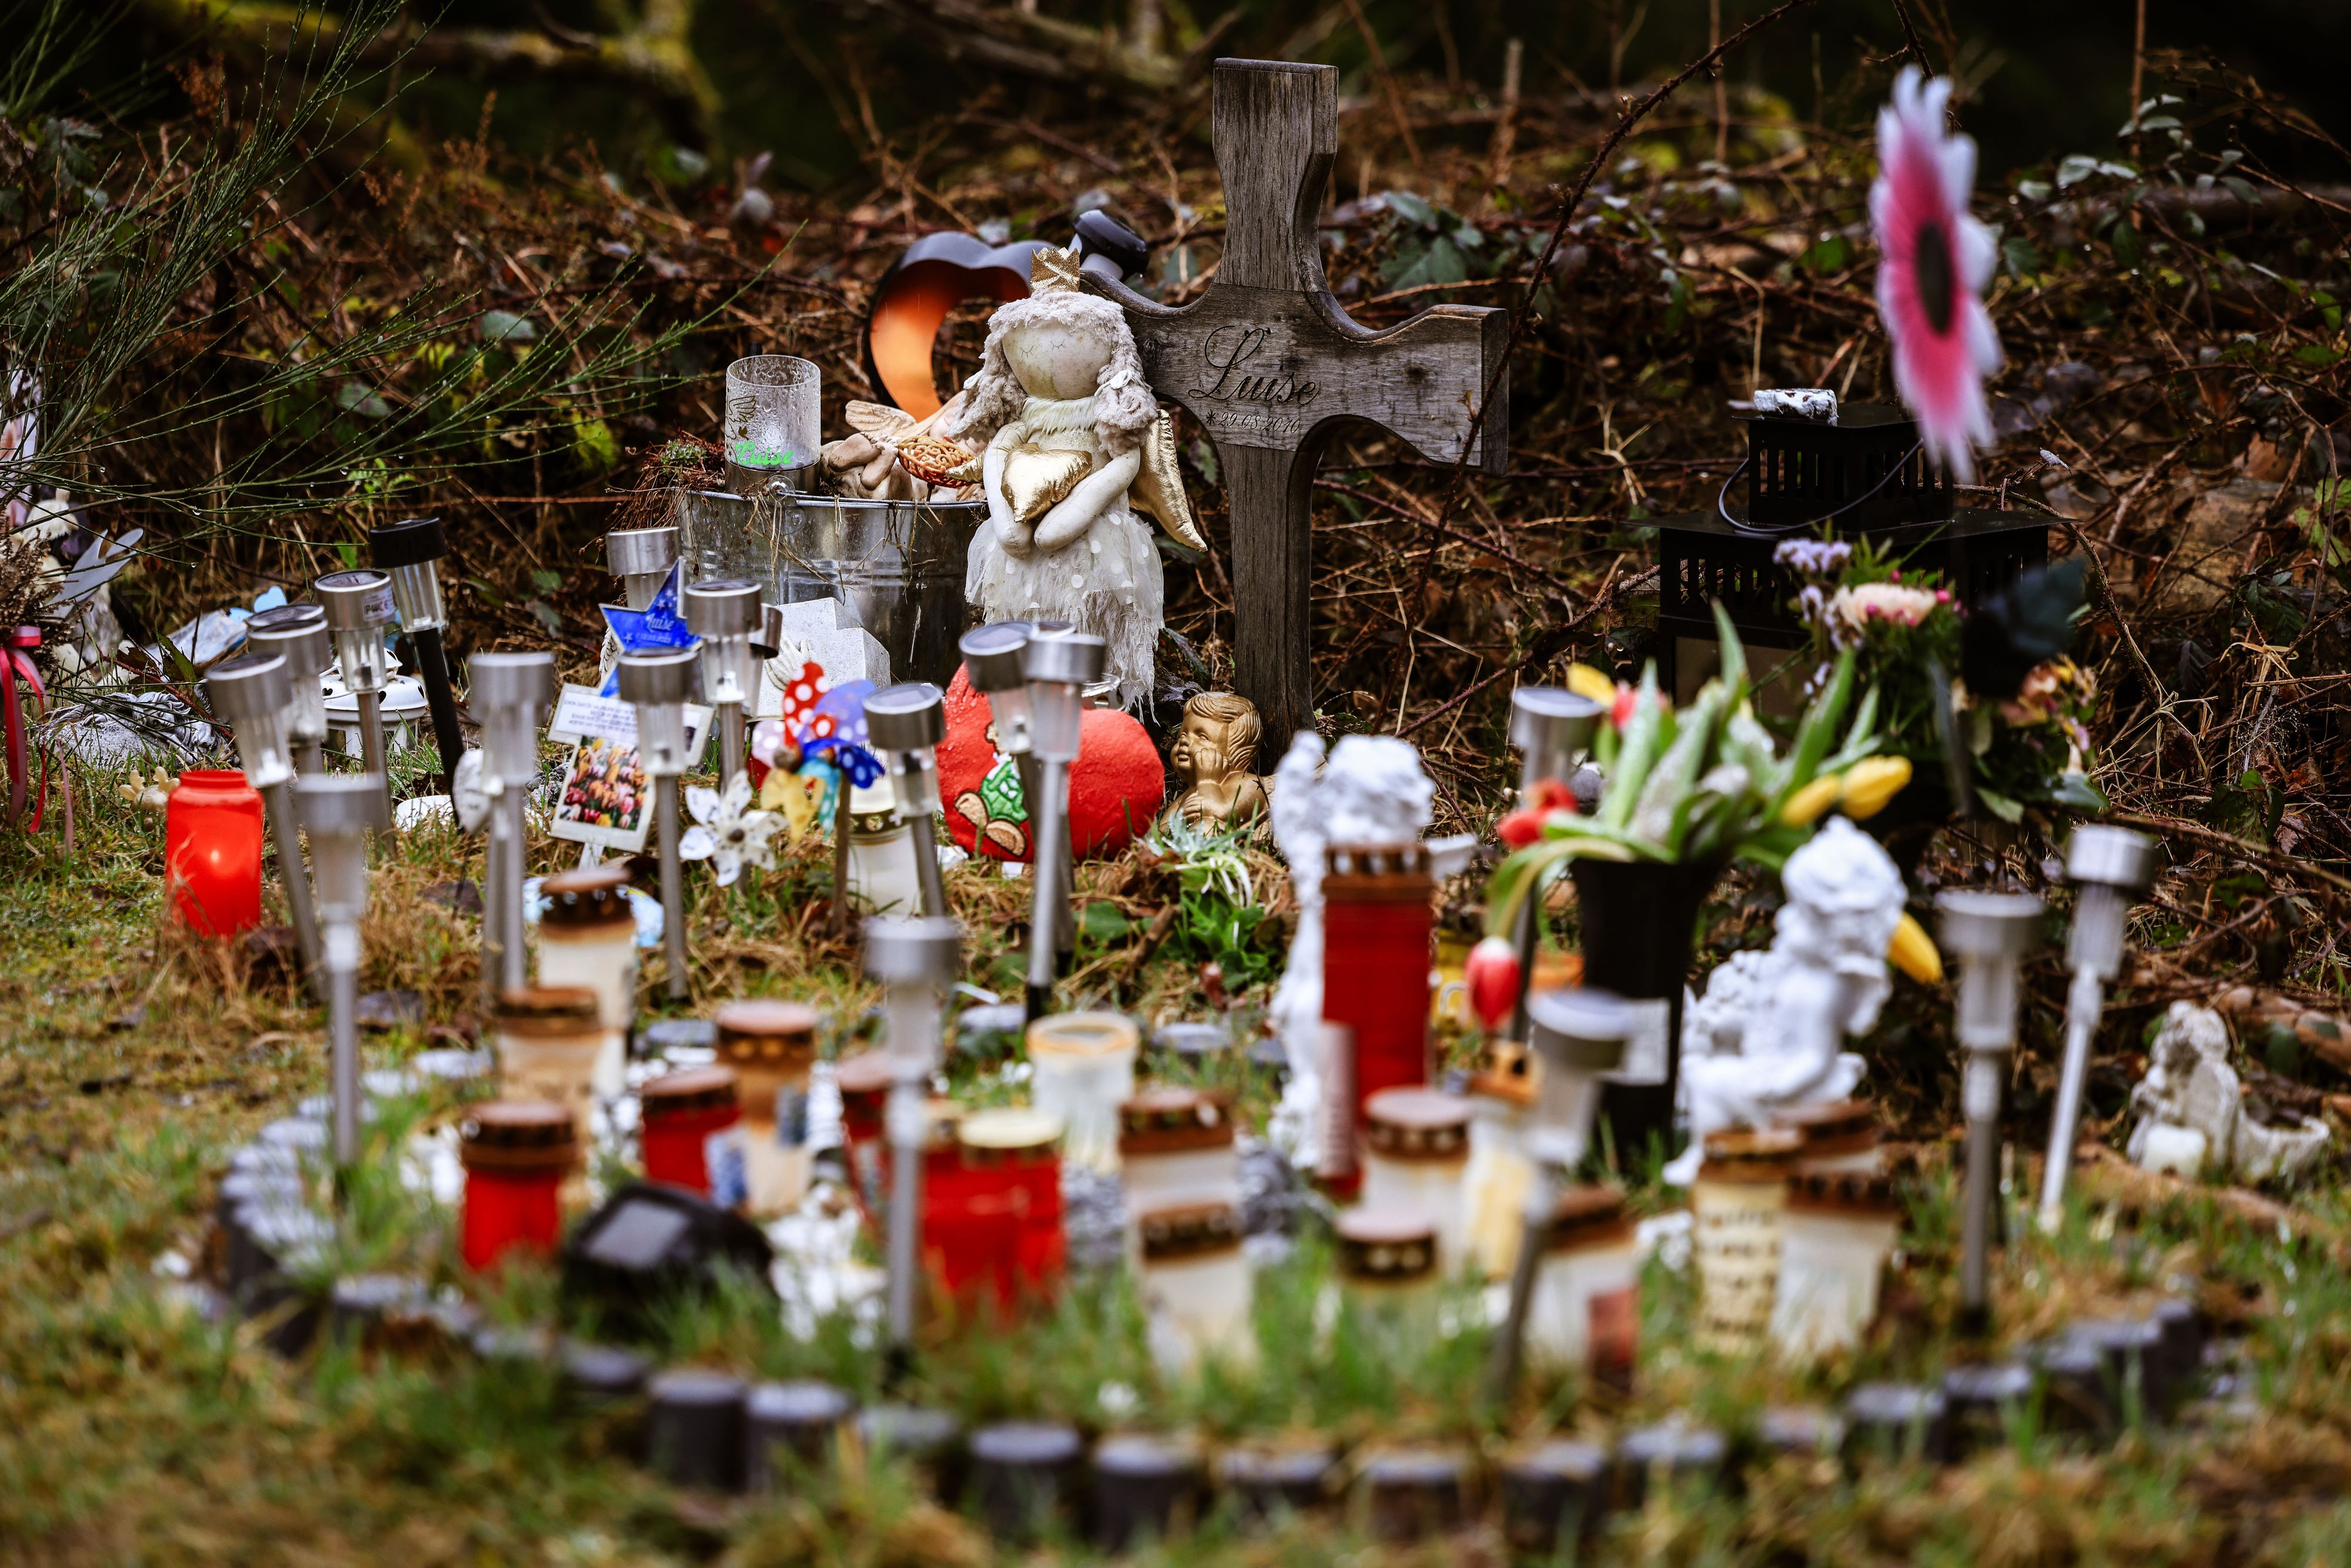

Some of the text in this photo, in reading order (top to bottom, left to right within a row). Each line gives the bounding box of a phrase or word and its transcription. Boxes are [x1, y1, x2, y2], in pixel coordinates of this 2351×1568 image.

[1188, 325, 1319, 406] Luise
[734, 441, 793, 465] Luise
[645, 613, 674, 634] Luise
